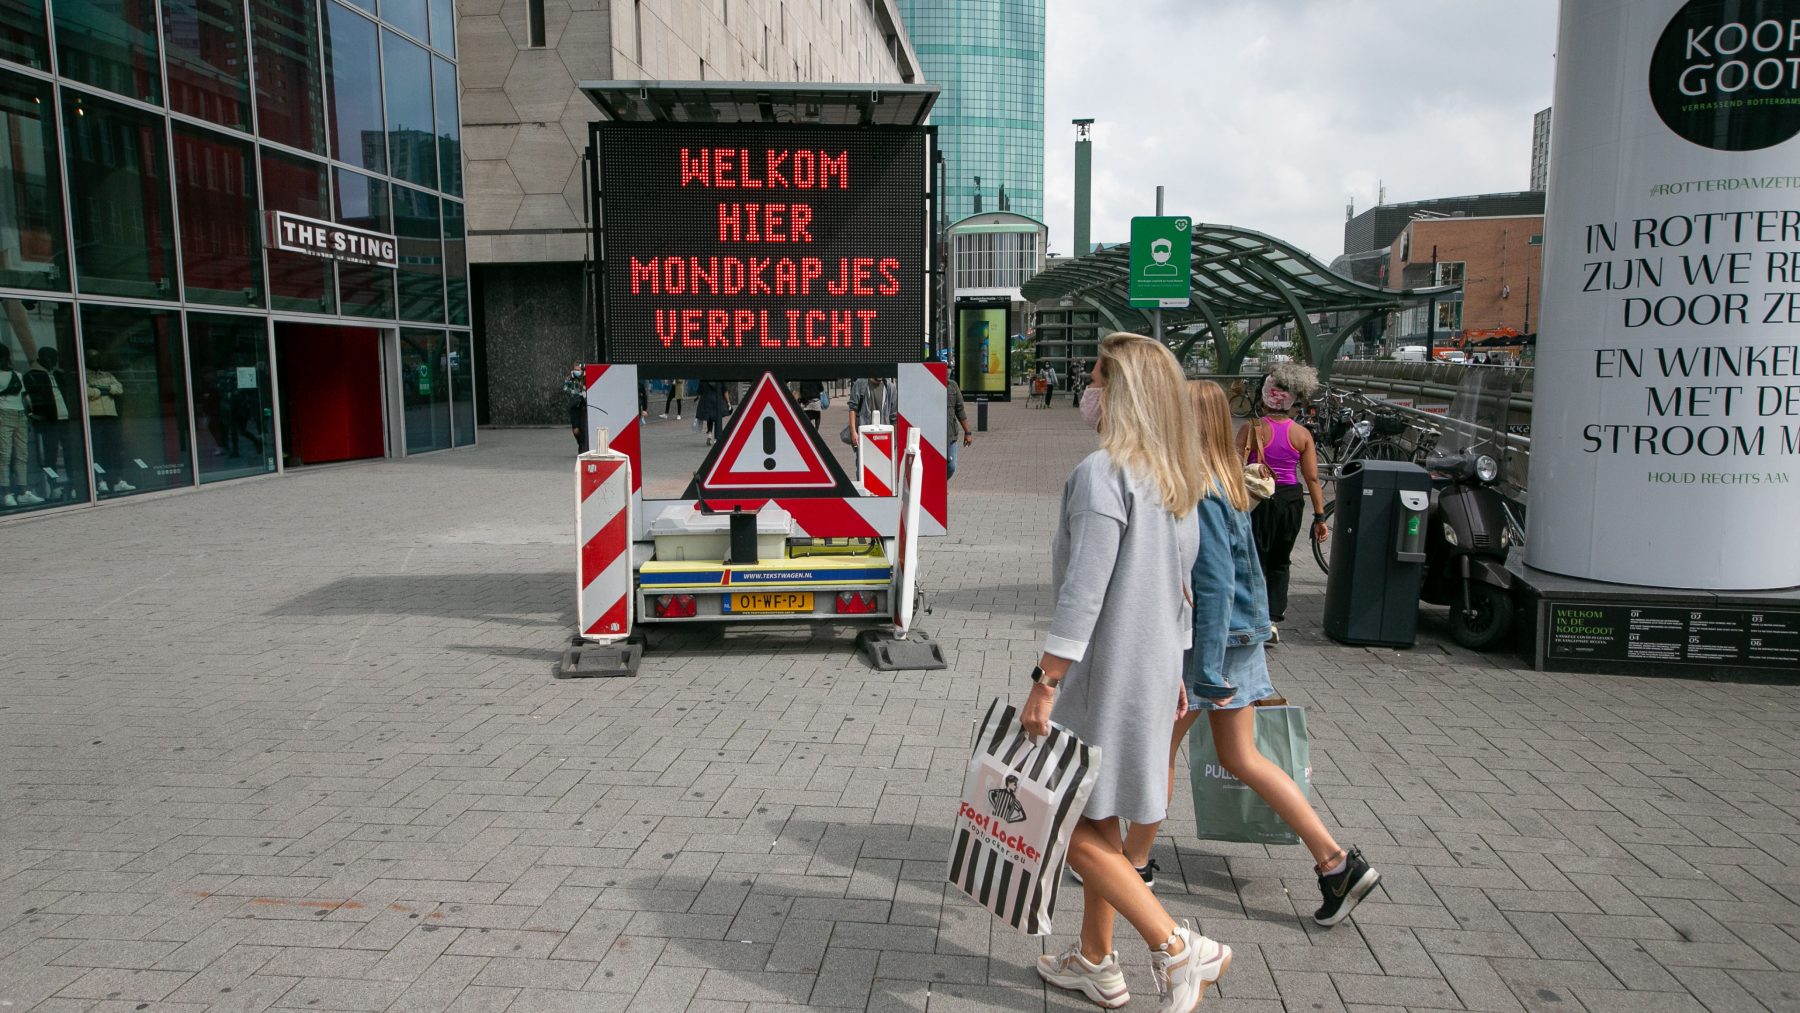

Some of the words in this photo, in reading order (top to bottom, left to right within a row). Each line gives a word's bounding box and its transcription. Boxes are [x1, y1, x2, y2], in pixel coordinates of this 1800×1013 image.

[1678, 57, 1800, 96] GOOT
[1681, 100, 1743, 112] VERRASSEND
[680, 147, 848, 189] WELKOM
[283, 221, 327, 248] THE
[334, 231, 393, 260] STING
[718, 203, 813, 242] HIER
[1585, 221, 1617, 254] IN
[1632, 210, 1800, 249] ROTTER
[629, 256, 901, 296] MONDKAPJES
[1582, 257, 1663, 292] ZIJN
[1678, 252, 1752, 286] WE
[655, 309, 877, 348] VERPLICHT
[1621, 294, 1749, 328] DOOR
[1594, 348, 1643, 378] EN
[1644, 386, 1743, 417] MET
[1756, 385, 1800, 417] DE
[1583, 424, 1766, 456] STROOM
[1647, 471, 1696, 484] HOUD
[1701, 472, 1760, 485] RECHTS
[1764, 472, 1790, 484] AAN
[740, 594, 805, 609] 01-WF-PJ
[1557, 609, 1603, 618] WELKOM
[1556, 625, 1615, 635] KOOPGOOT
[1570, 618, 1585, 626] DE
[959, 801, 990, 832] Foot
[991, 820, 1041, 863] Locker
[968, 820, 1026, 864] footlocker.eu
